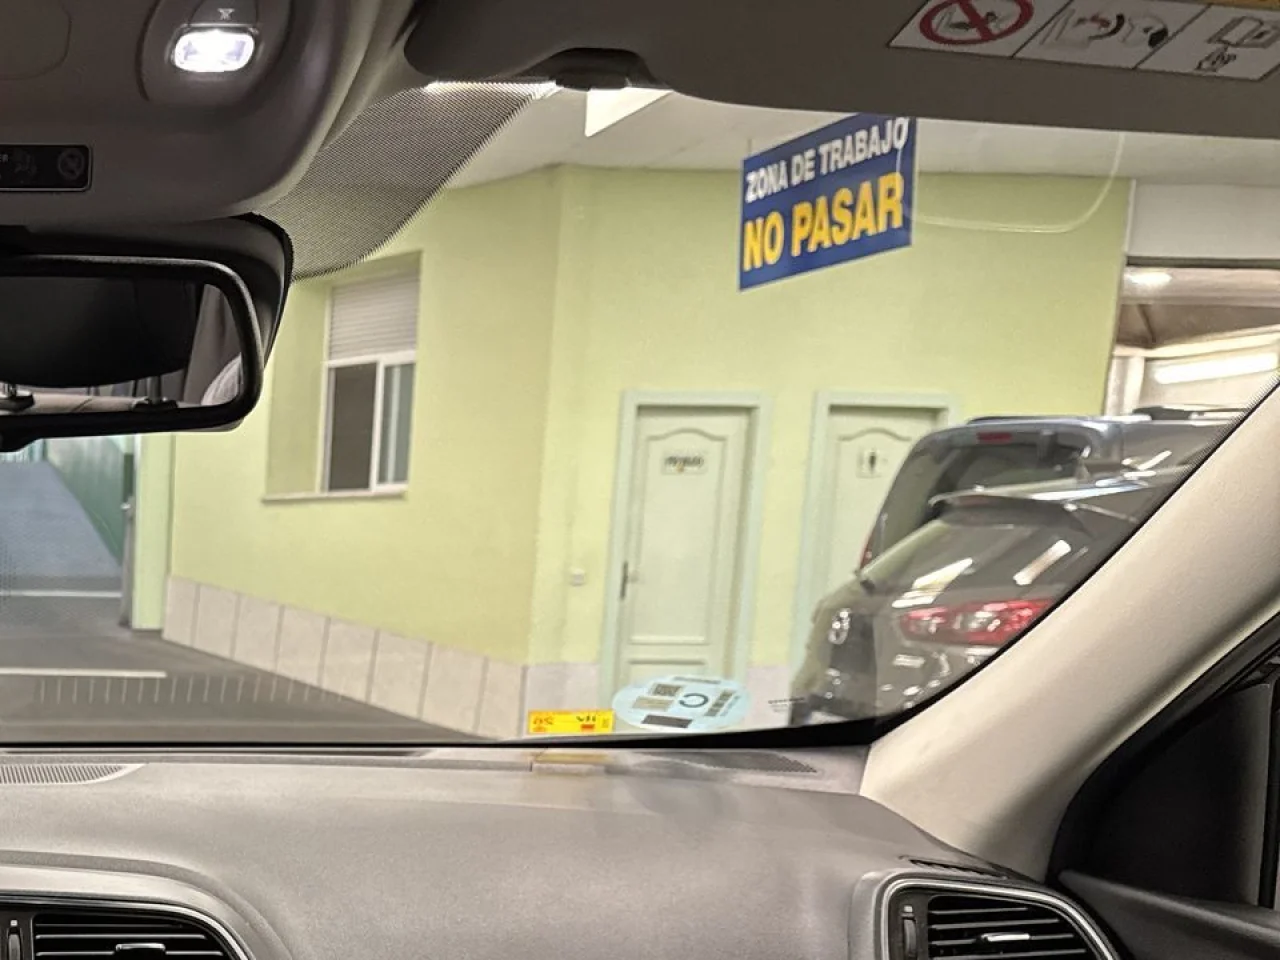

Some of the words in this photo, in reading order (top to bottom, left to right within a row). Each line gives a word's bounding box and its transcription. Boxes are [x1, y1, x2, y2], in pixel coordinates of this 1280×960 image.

[745, 160, 789, 203] ZONA
[791, 149, 816, 186] DE
[818, 117, 910, 176] TRABAJO
[743, 211, 785, 272] NO
[791, 172, 905, 257] PASAR
